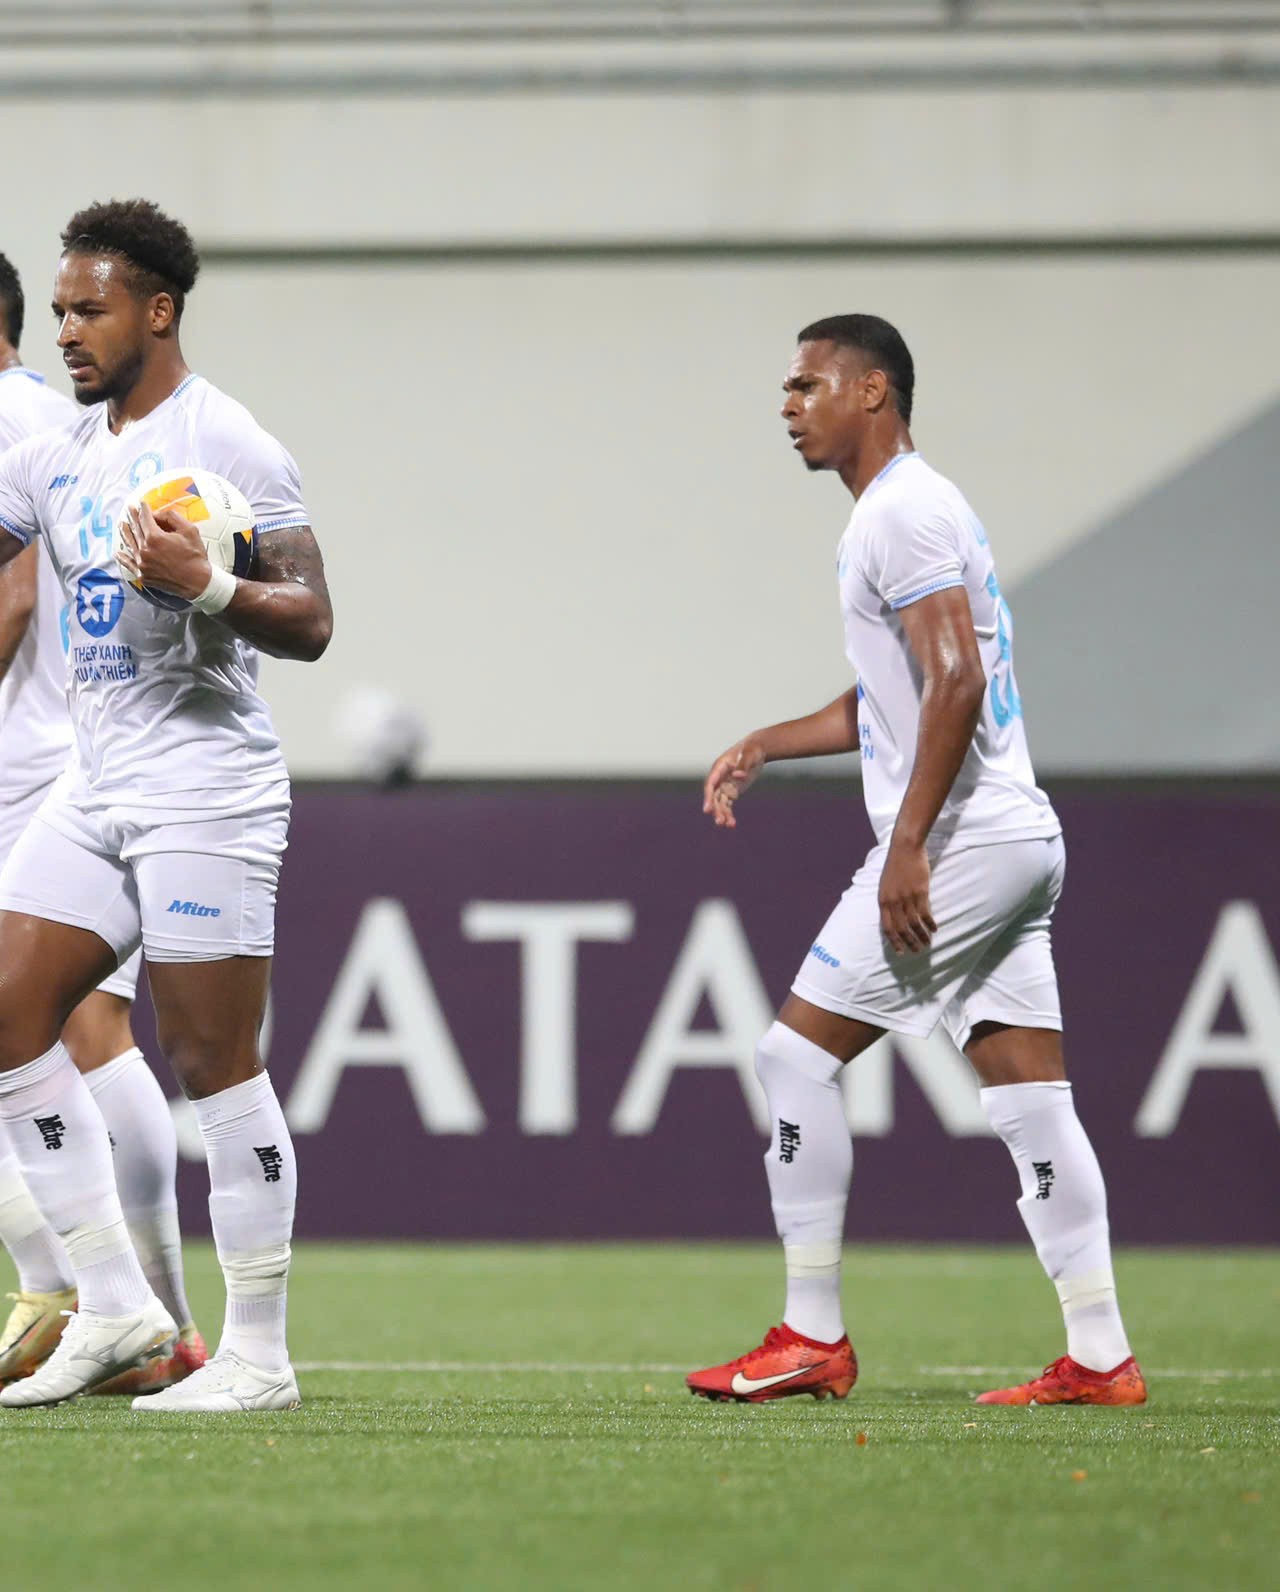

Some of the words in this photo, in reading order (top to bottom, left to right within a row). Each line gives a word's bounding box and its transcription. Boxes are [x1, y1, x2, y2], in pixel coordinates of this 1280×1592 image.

[78, 495, 113, 560] 14
[99, 645, 132, 661] XANH
[167, 900, 220, 918] Mitre
[33, 1114, 66, 1150] Mitre
[779, 1118, 801, 1164] Mitre
[253, 1144, 281, 1183] Mitre
[1032, 1159, 1056, 1201] Mitre
